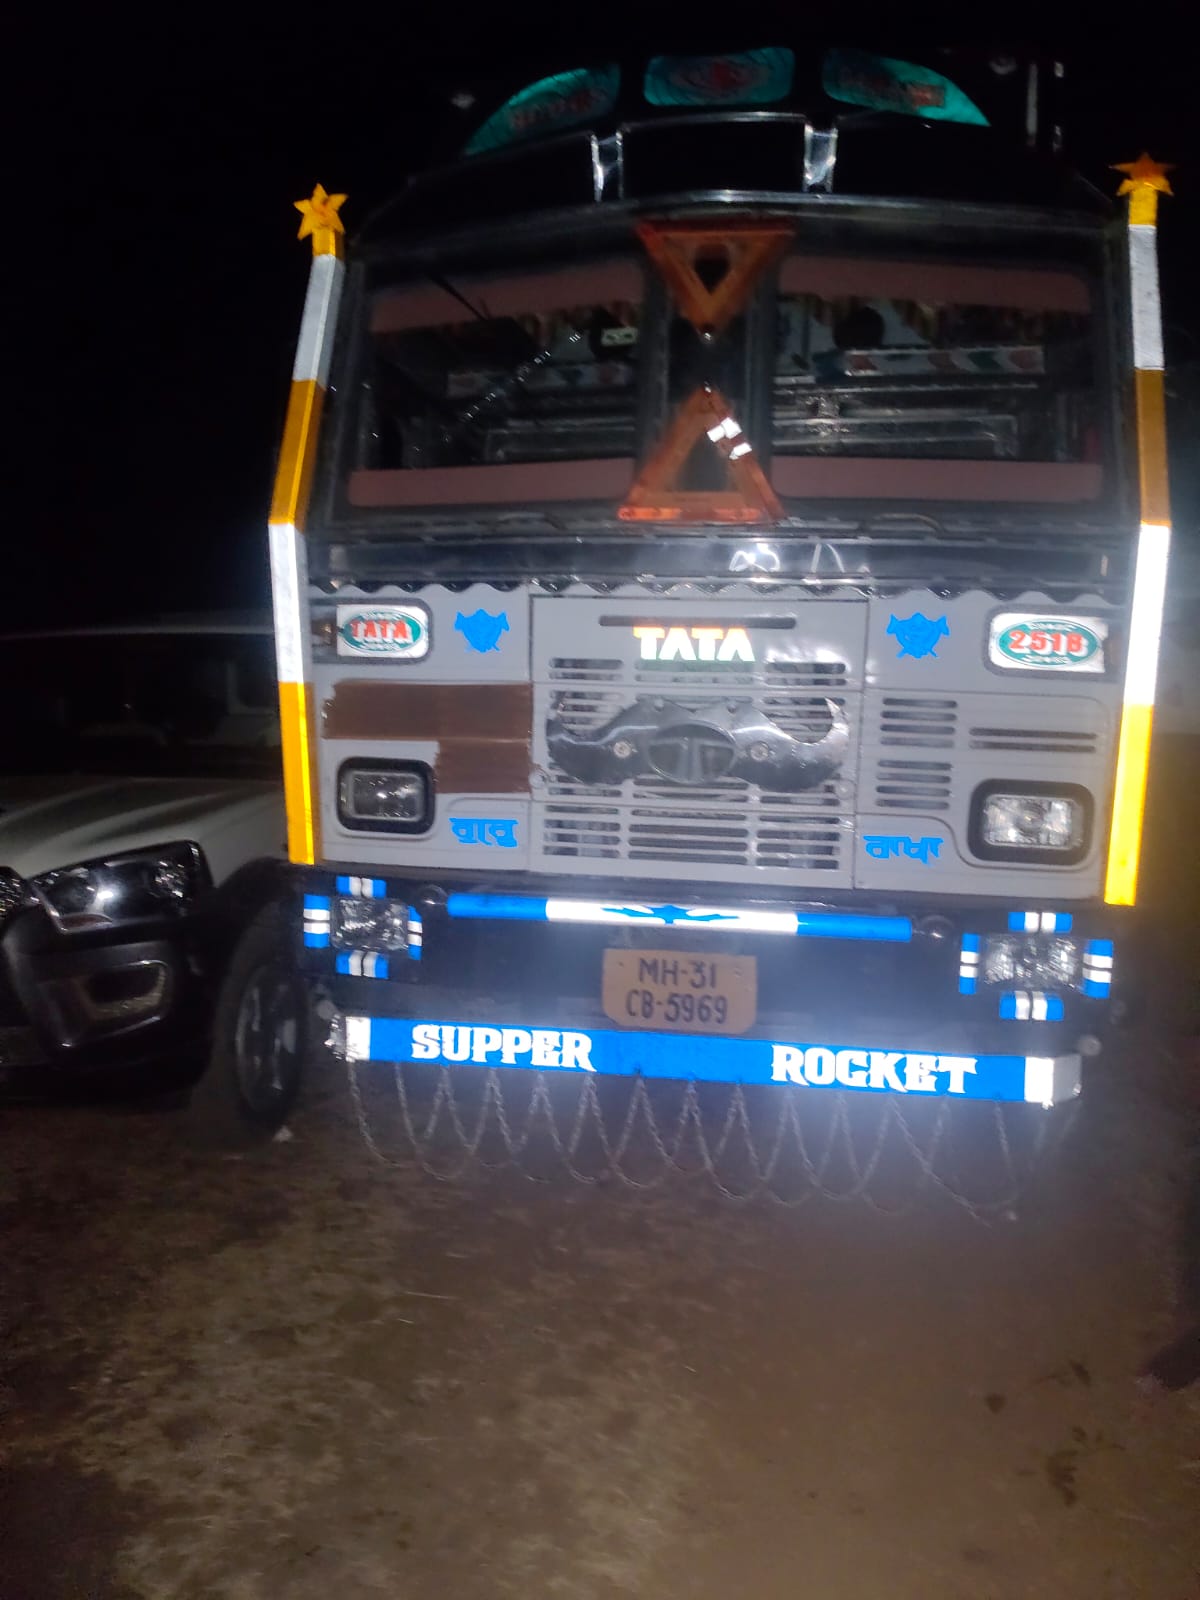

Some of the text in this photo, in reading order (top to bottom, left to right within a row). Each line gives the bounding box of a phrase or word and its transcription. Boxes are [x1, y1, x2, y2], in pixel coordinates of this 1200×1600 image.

[348, 618, 411, 641] TATA
[633, 626, 755, 661] TATA
[1008, 629, 1088, 657] 2518
[638, 957, 719, 990] MH-31
[411, 1024, 978, 1094] SUPPER ROCKET
